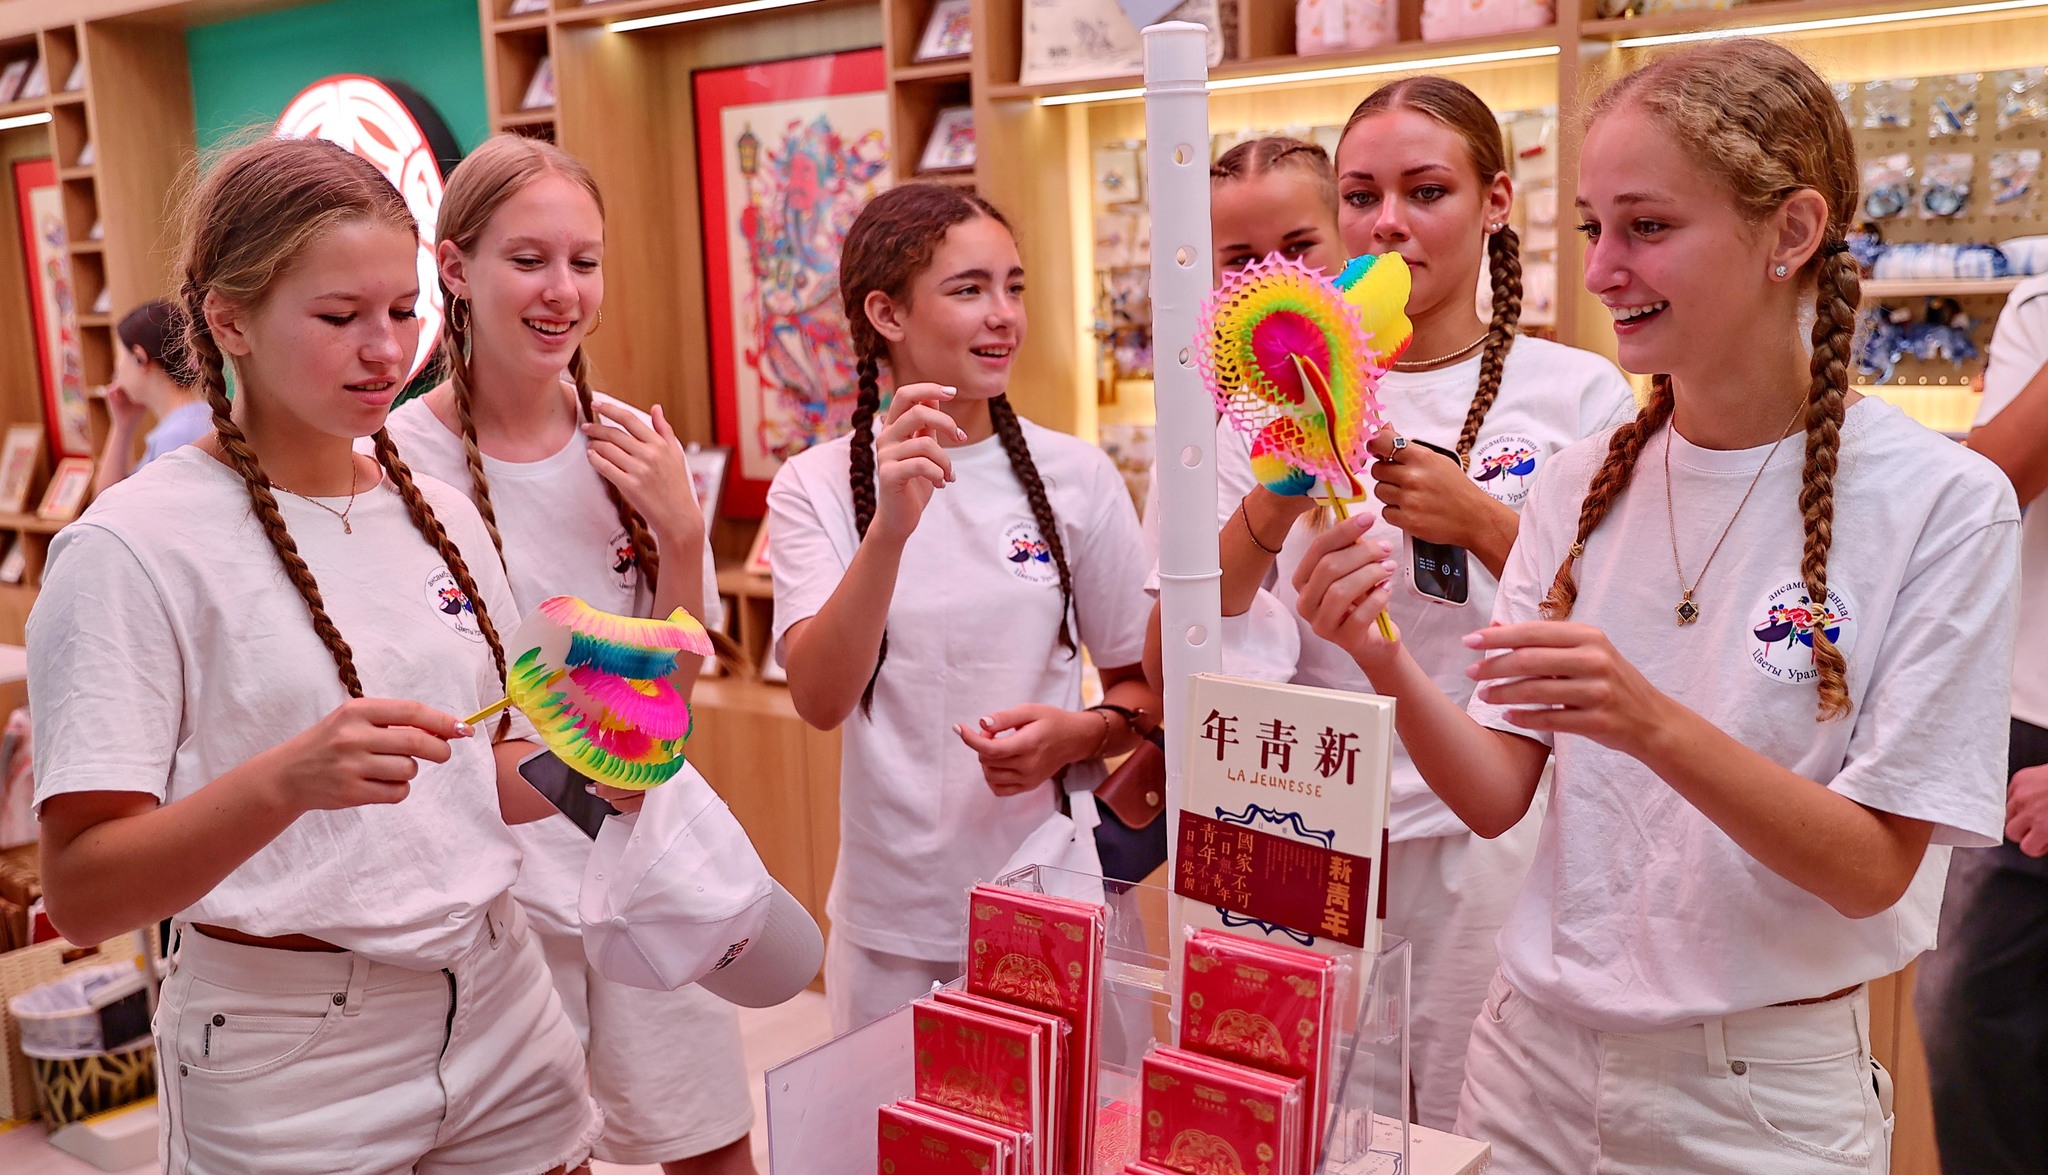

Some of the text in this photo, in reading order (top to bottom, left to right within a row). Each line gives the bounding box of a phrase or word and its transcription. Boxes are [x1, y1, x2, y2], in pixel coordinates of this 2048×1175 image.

[1477, 435, 1514, 456] ансамбль
[1507, 488, 1529, 503] Урал
[1752, 648, 1820, 682] Цветы Урал
[1227, 767, 1322, 798] LA JEUNESSE
